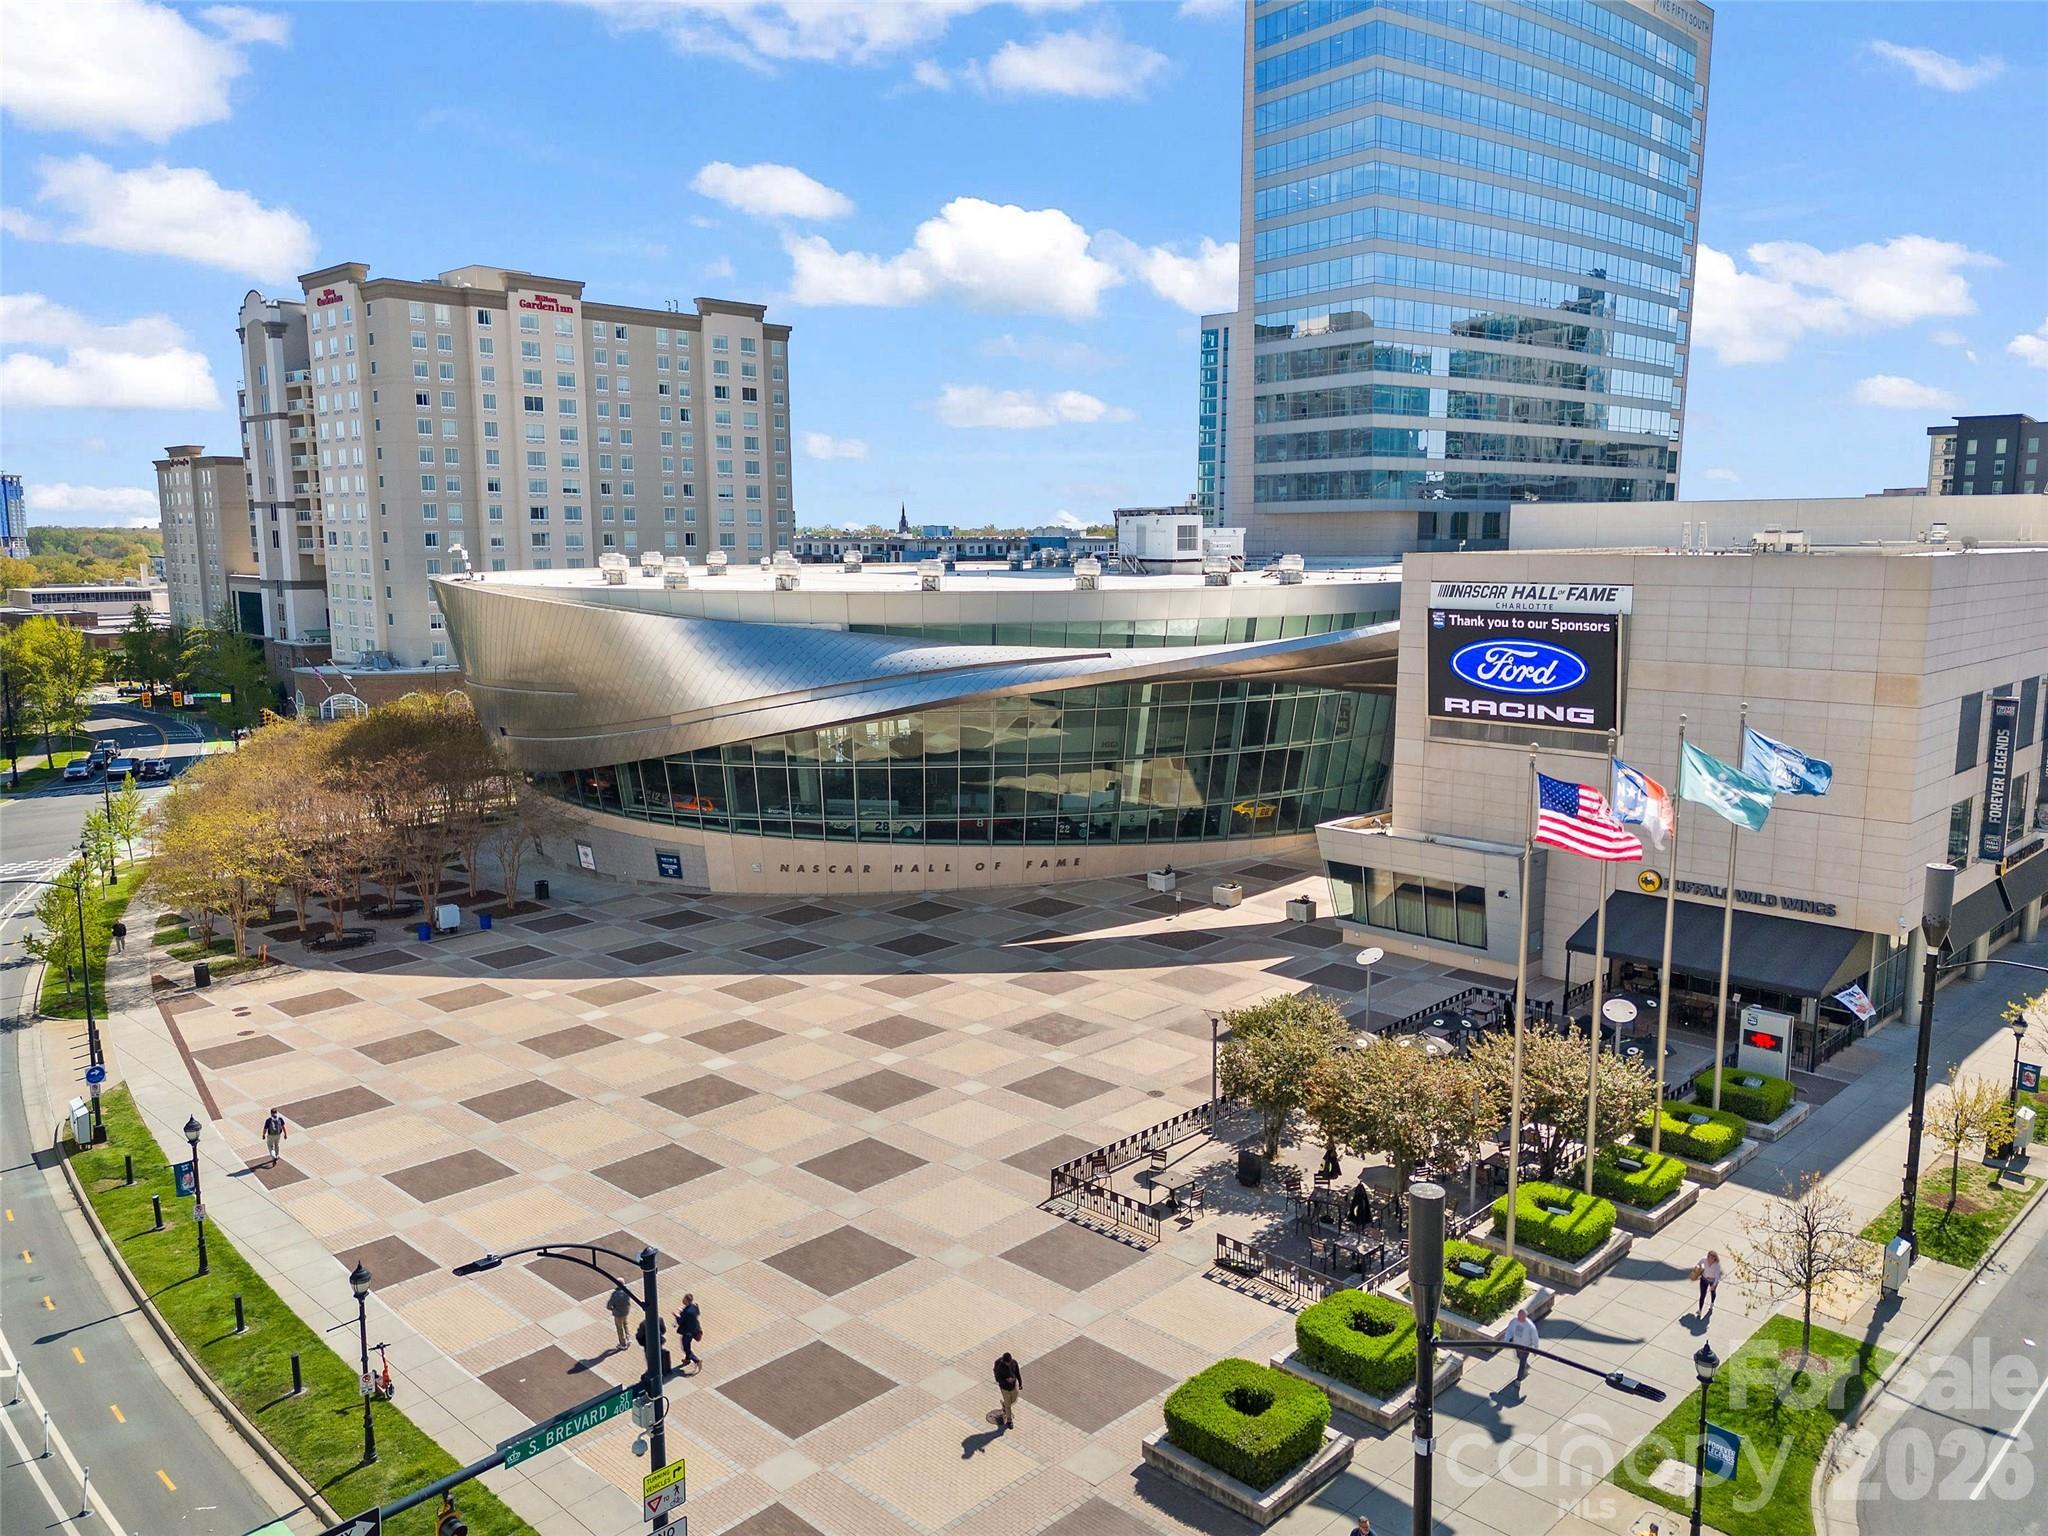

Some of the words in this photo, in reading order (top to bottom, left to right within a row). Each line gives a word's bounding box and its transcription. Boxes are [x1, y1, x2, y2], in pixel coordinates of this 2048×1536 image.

[1671, 3, 1688, 21] FIFTY
[1689, 14, 1709, 32] SOUTH
[519, 299, 555, 312] Garden
[555, 303, 574, 313] Inn
[534, 294, 558, 304] Hilton
[1450, 584, 1508, 599] NASCAR
[1511, 585, 1558, 600] HALL
[1566, 586, 1619, 602] FAME
[1495, 602, 1554, 611] CHARLOTTE
[1449, 614, 1485, 628] Thank
[1488, 618, 1508, 630] you
[1512, 617, 1525, 629] to
[1529, 620, 1549, 630] our
[1551, 618, 1611, 633] Sponsors
[1477, 647, 1559, 685] Ford
[1444, 697, 1595, 725] RACING
[1994, 729, 2010, 775] LEGENDS
[1989, 777, 2005, 824] FOREVER
[875, 821, 890, 832] 28
[1058, 824, 1071, 834] 22
[779, 863, 872, 873] NASCAR
[893, 863, 951, 873] HALL
[975, 861, 1001, 871] OF
[1025, 857, 1081, 869] FAME
[1735, 889, 1777, 907] WILD
[1780, 896, 1837, 917] WINGS
[620, 1391, 629, 1405] ST
[613, 1401, 630, 1415] 400
[528, 1440, 541, 1455] S.
[546, 1405, 607, 1447] BREVARD
[1707, 1440, 1736, 1457] FOREVER
[1707, 1448, 1735, 1464] LEGENDS
[647, 1469, 671, 1485] TURNING
[646, 1477, 672, 1494] VEHICLES
[663, 1495, 670, 1503] TO
